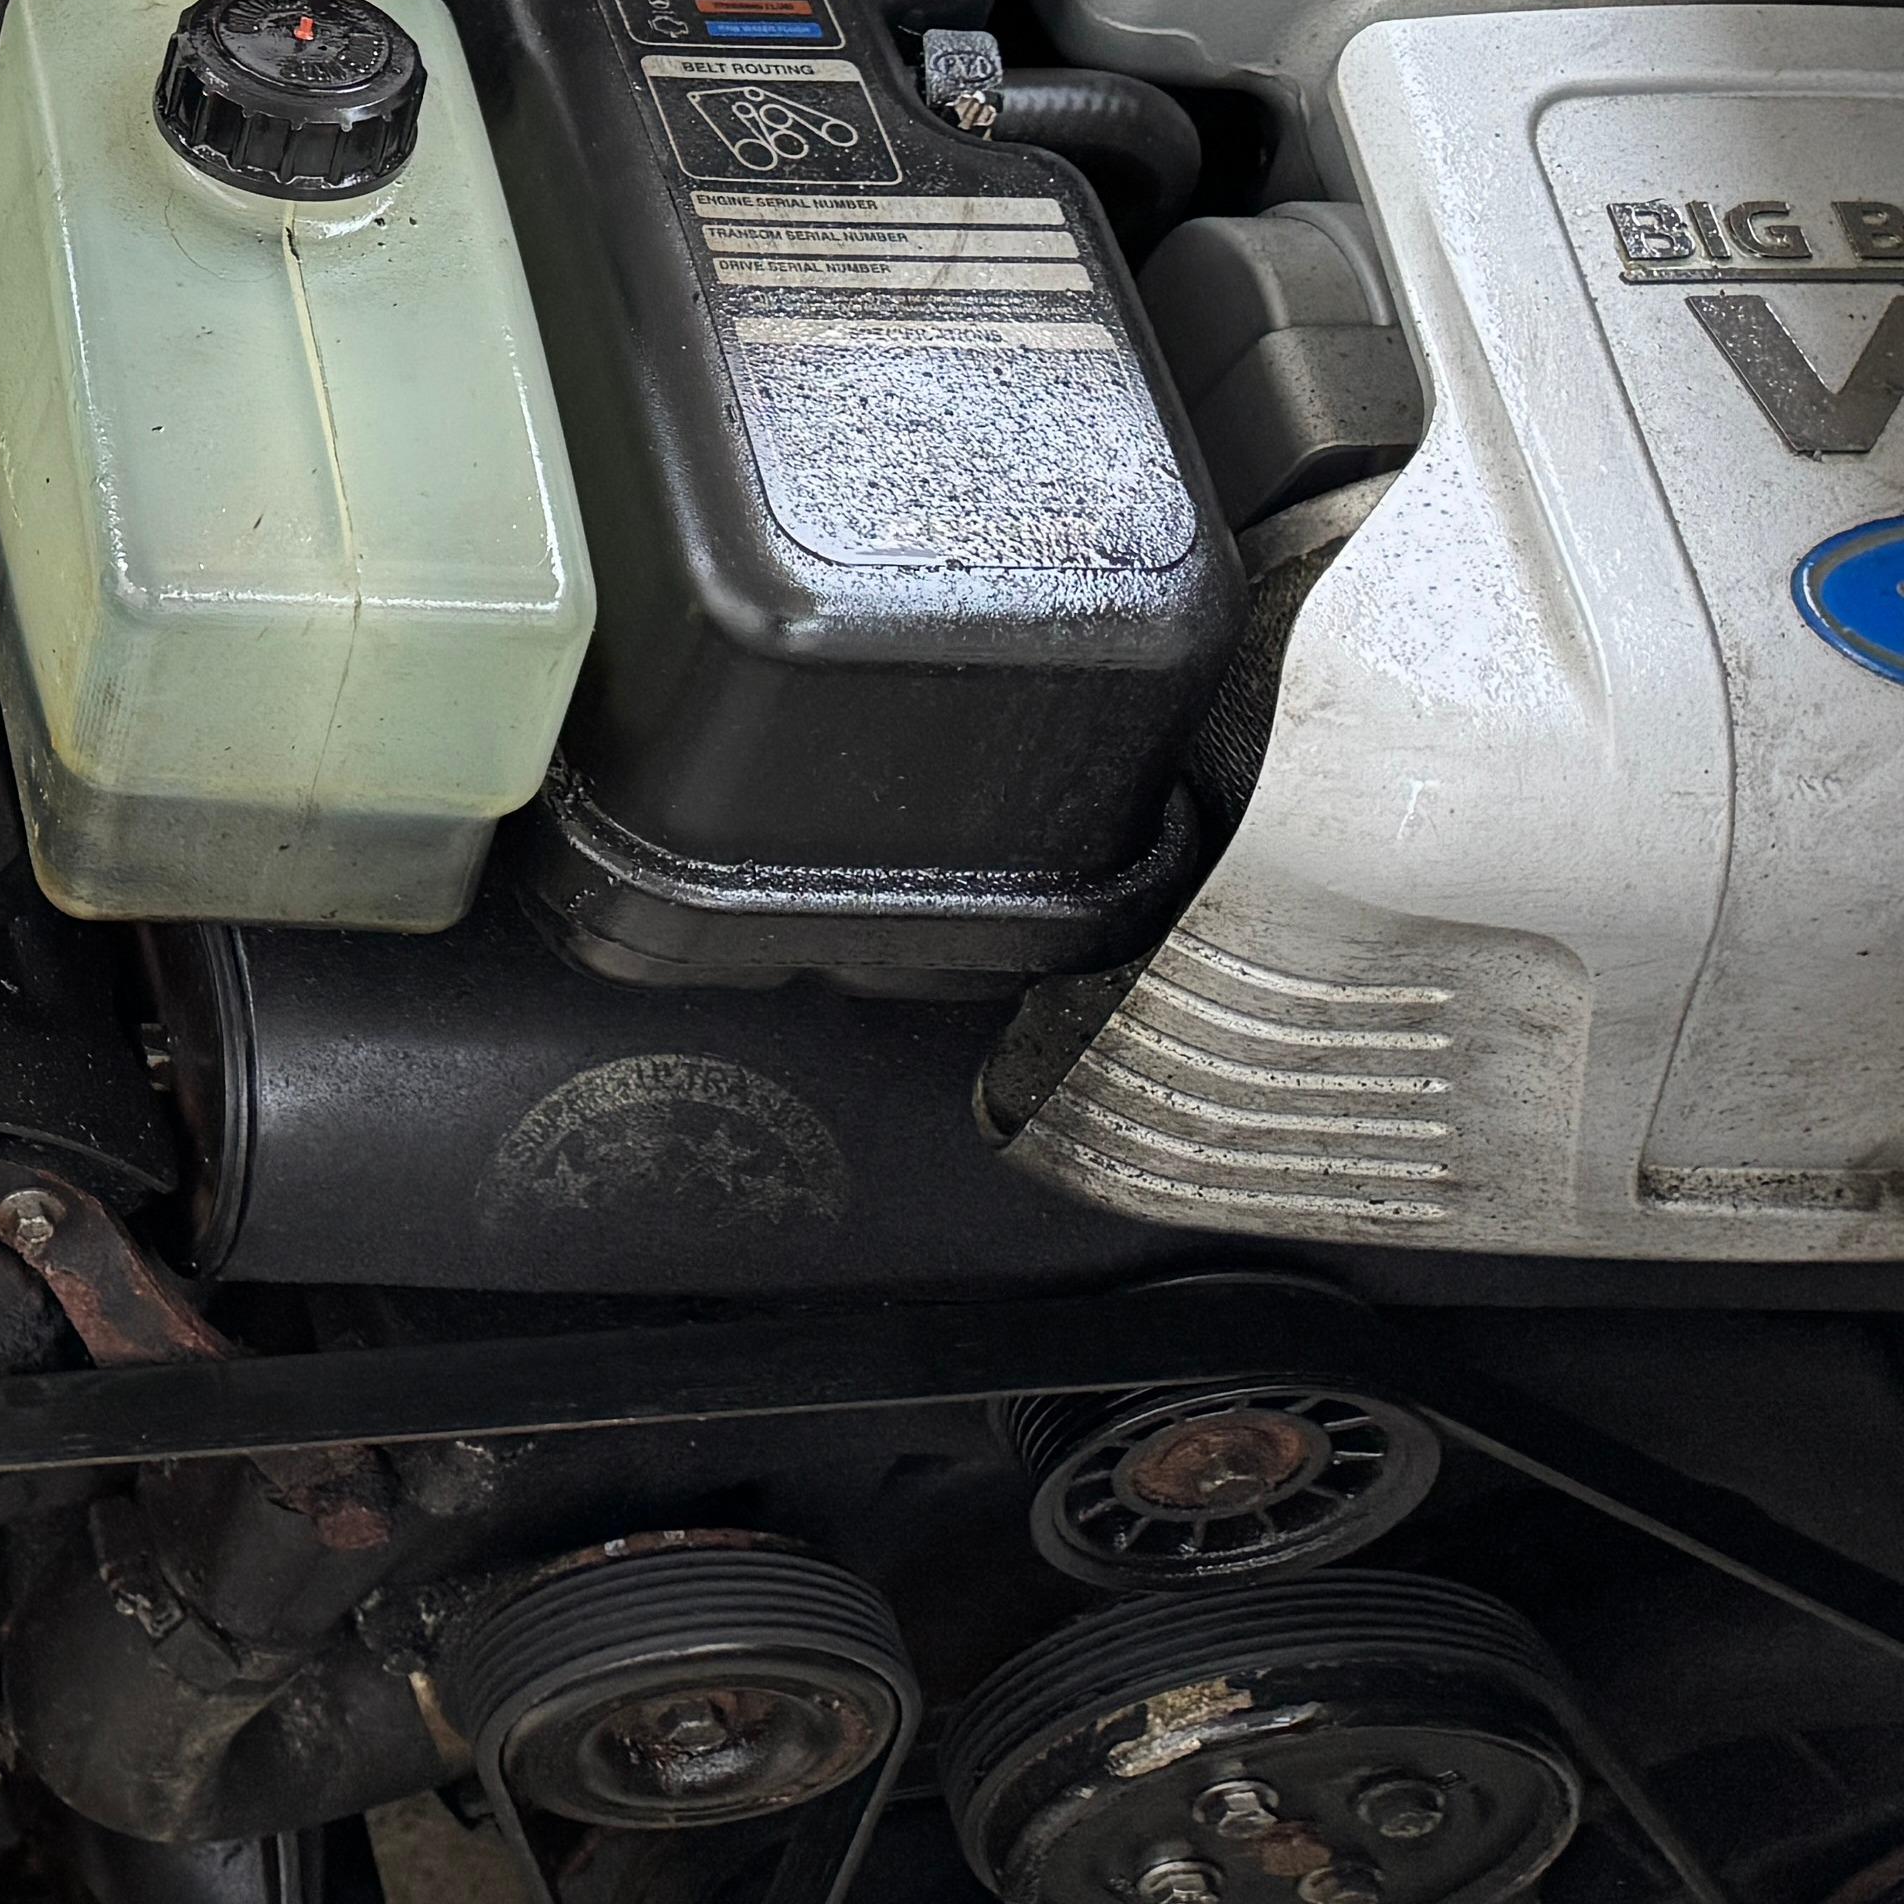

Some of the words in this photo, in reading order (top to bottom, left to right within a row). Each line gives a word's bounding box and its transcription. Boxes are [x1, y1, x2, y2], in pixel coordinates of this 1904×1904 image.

[682, 61, 725, 73] BELT
[731, 62, 816, 76] ROUTING
[696, 194, 753, 208] ENGINE
[756, 197, 811, 210] SERIAL
[813, 198, 879, 211] NUMBER
[708, 227, 782, 242] TRANSOM
[786, 230, 840, 243] SERIAL
[842, 231, 909, 244] NUMBER
[1606, 199, 1813, 261] BIG
[719, 259, 765, 272] DRIVE
[767, 260, 823, 273] SERIAL
[825, 262, 892, 274] NUMBER
